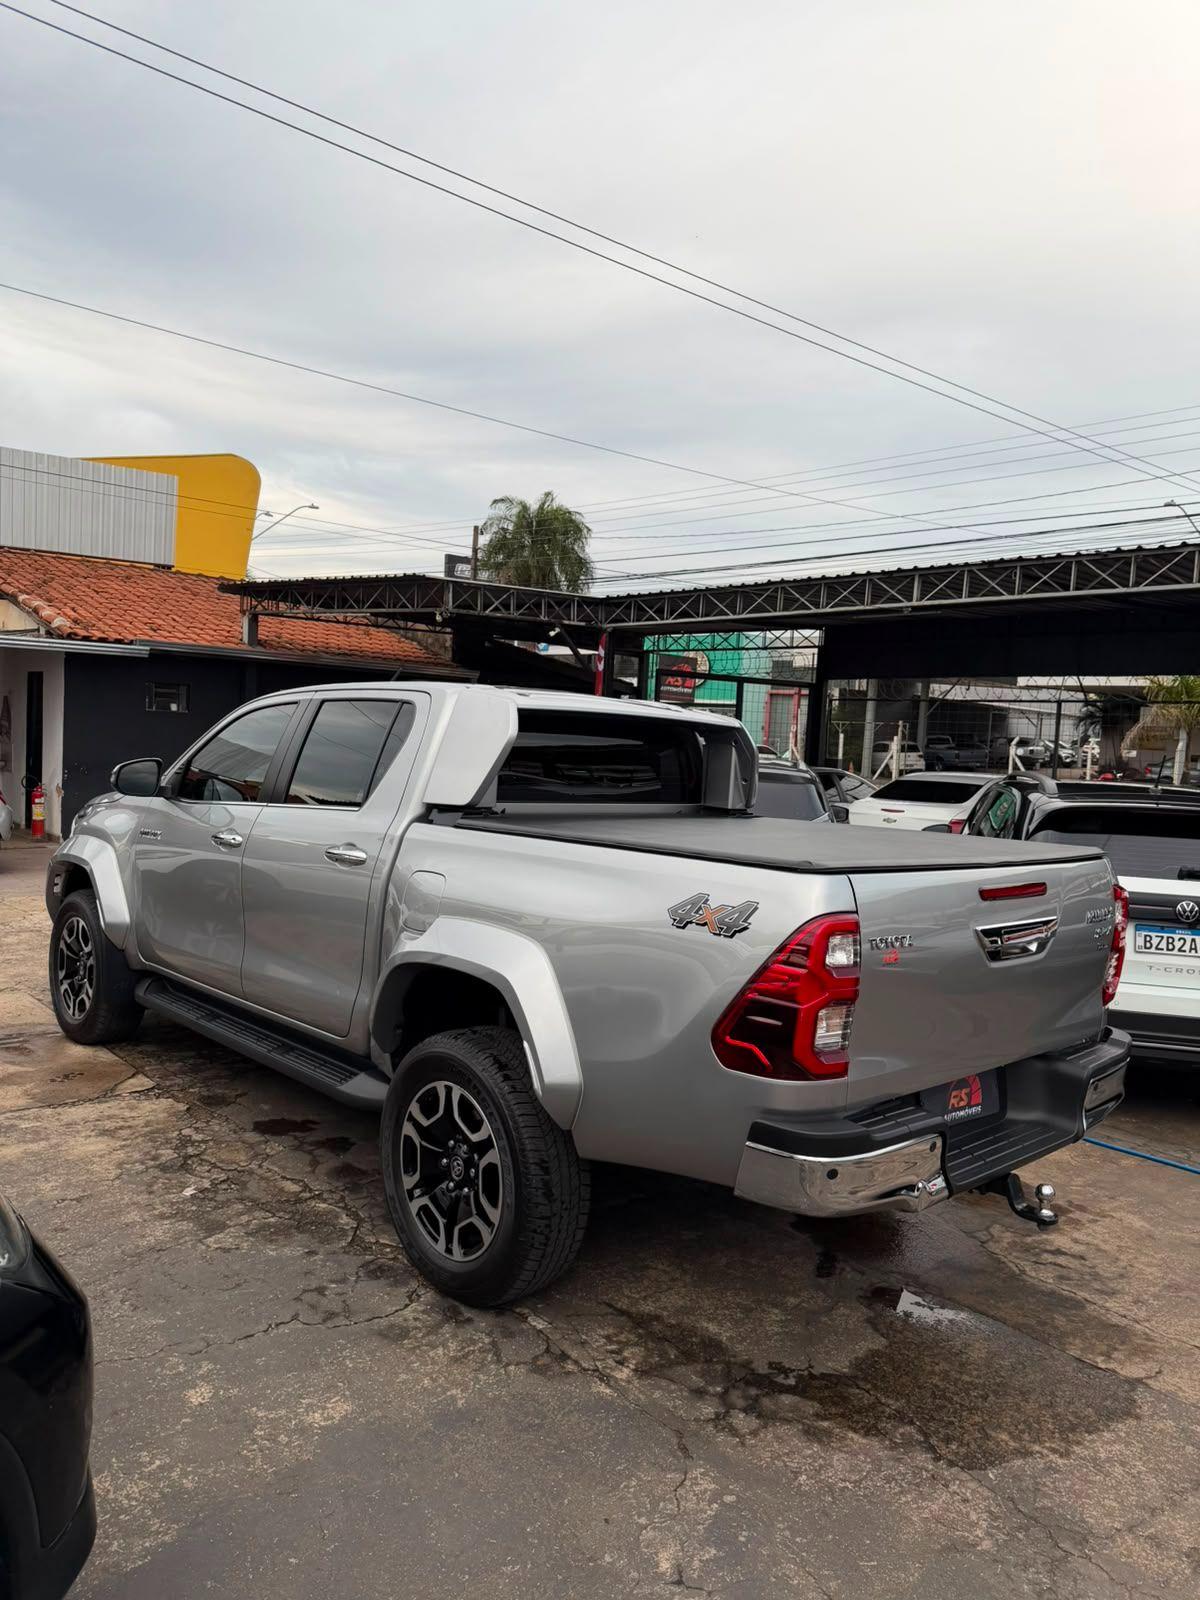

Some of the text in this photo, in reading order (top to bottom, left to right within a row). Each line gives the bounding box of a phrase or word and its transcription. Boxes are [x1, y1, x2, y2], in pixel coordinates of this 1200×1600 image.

[868, 934, 913, 951] TOYOTA
[1143, 934, 1198, 954] BZB2A
[948, 1088, 970, 1109] RS
